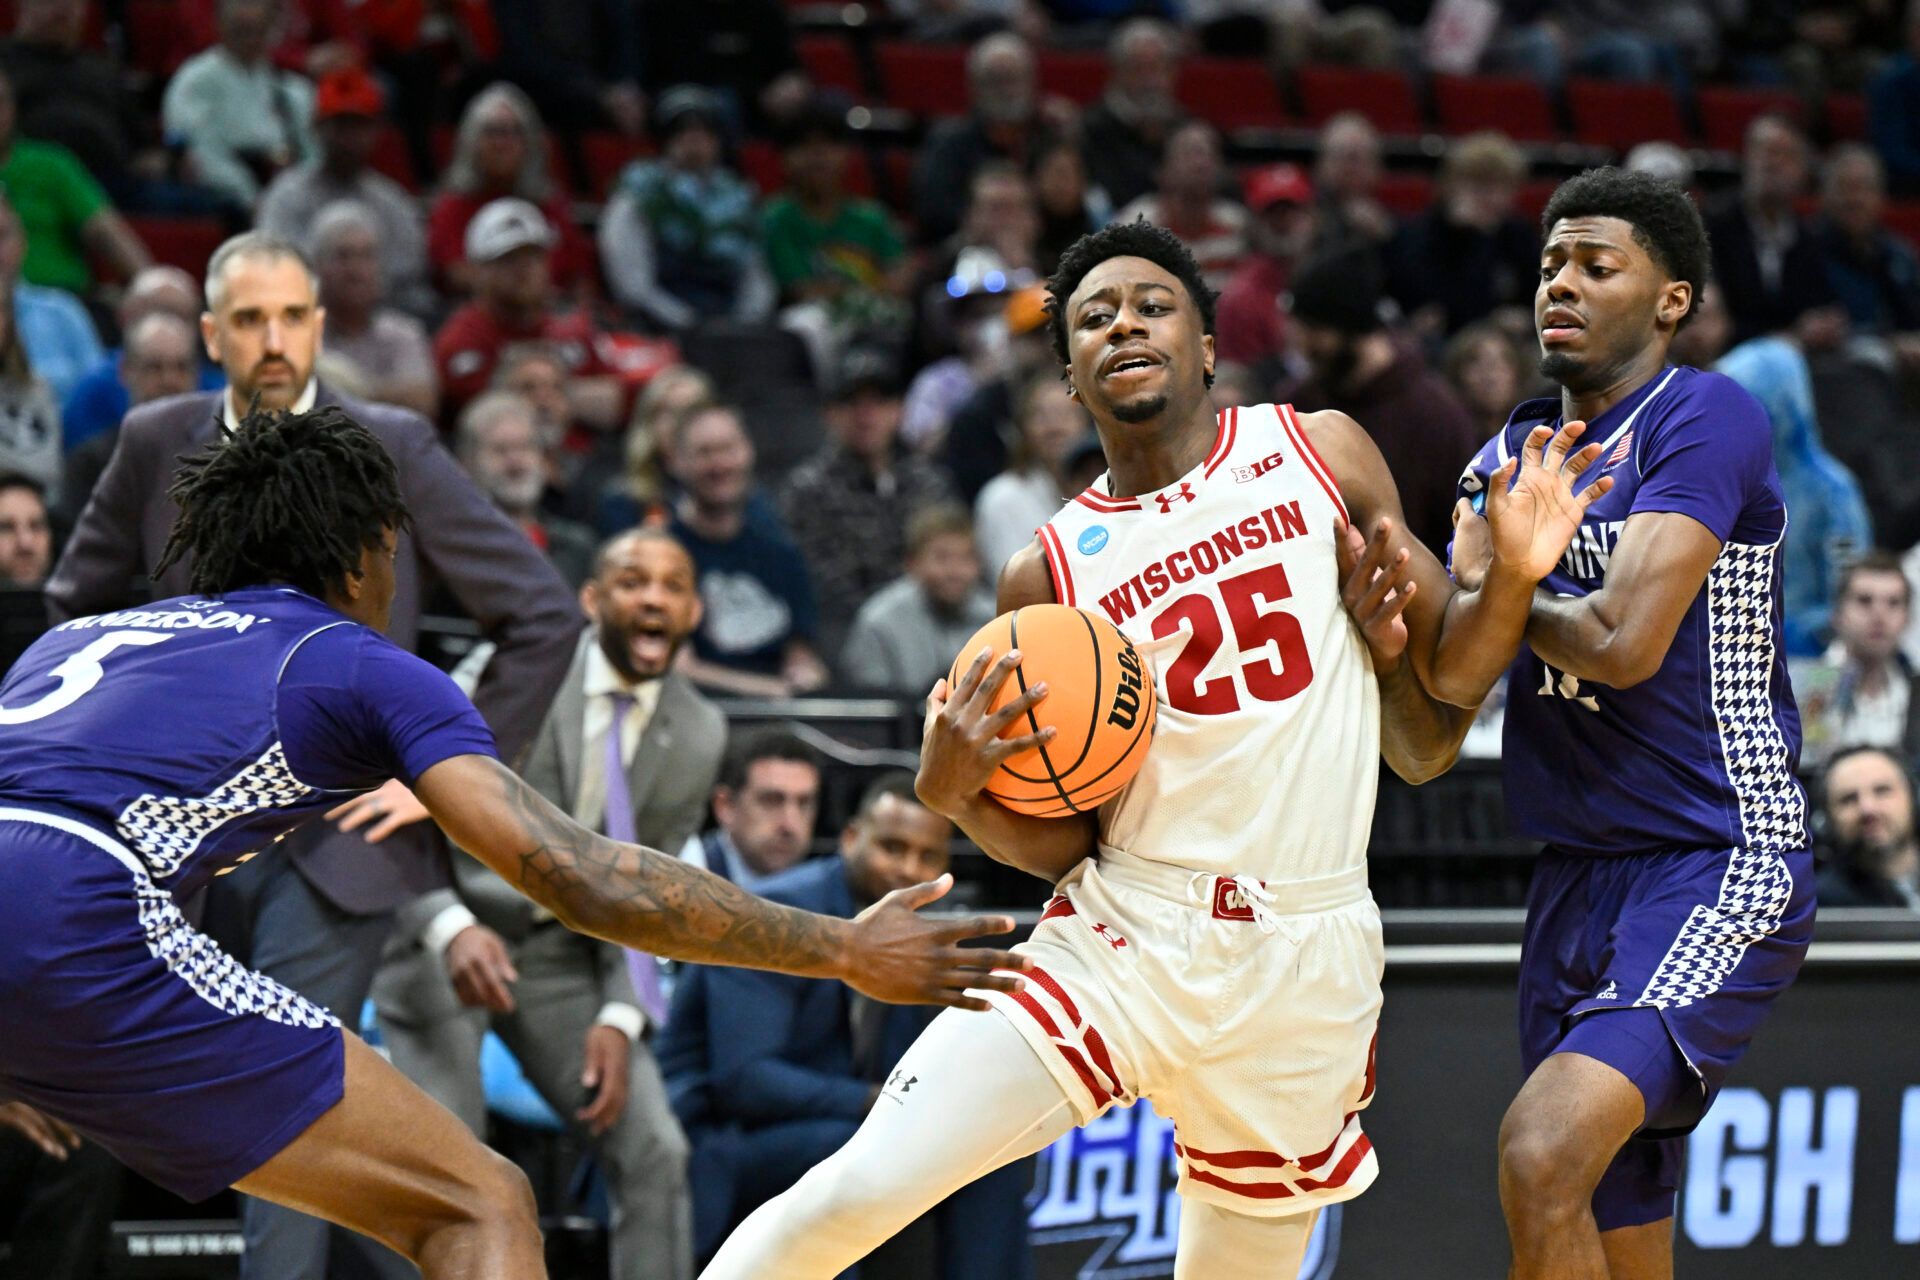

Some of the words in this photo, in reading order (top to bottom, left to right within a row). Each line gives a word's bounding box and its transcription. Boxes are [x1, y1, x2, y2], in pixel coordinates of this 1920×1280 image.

[57, 610, 272, 634] ANDERSON
[1097, 500, 1308, 627] WISCONSIN
[1150, 562, 1314, 716] 25
[1683, 1086, 1860, 1249] GH
